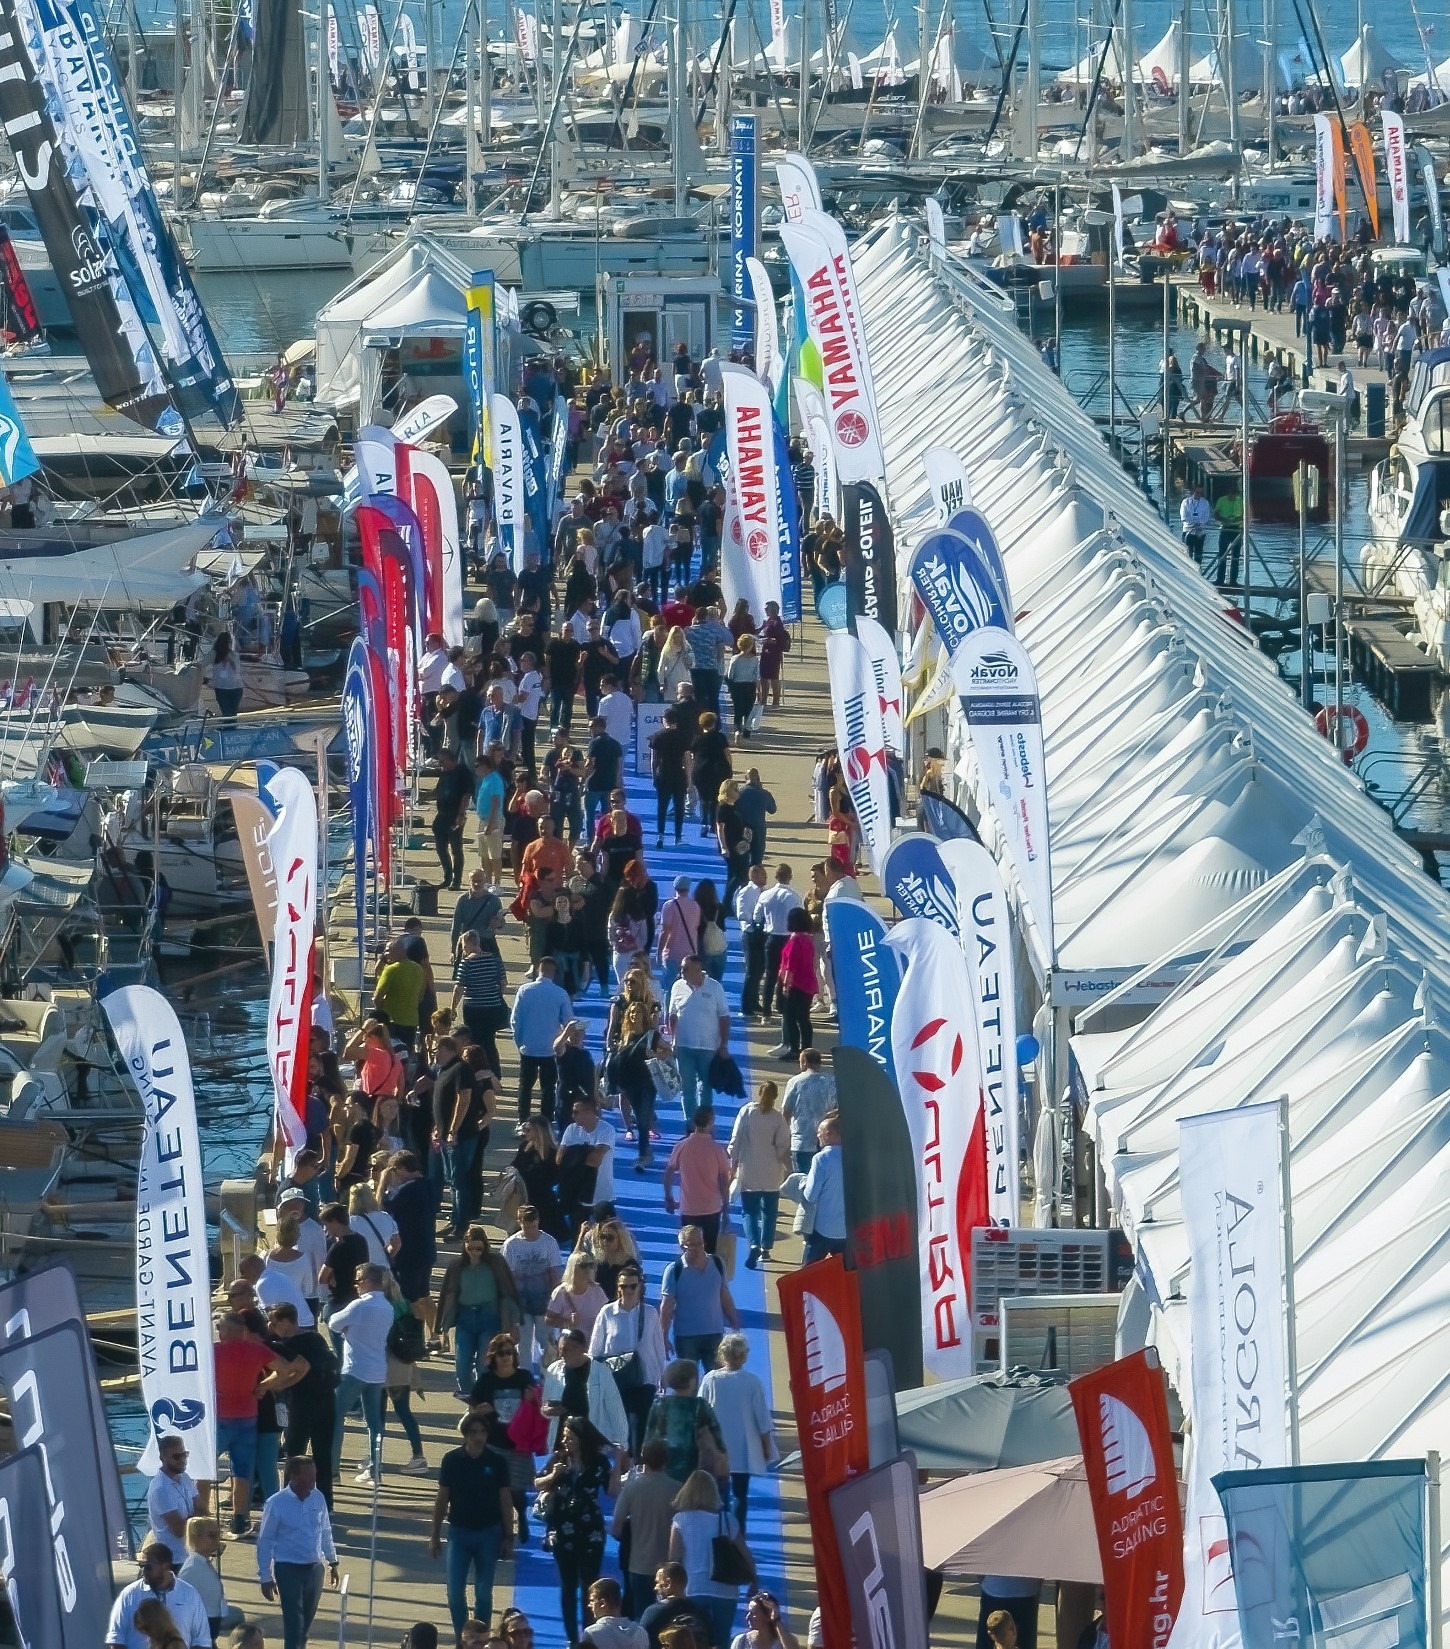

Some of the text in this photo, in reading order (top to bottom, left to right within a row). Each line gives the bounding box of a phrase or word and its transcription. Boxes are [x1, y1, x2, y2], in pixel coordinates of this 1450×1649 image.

[734, 158, 743, 239] KORNATI
[807, 265, 860, 410] YAMAHA
[855, 1212, 913, 1268] 3M
